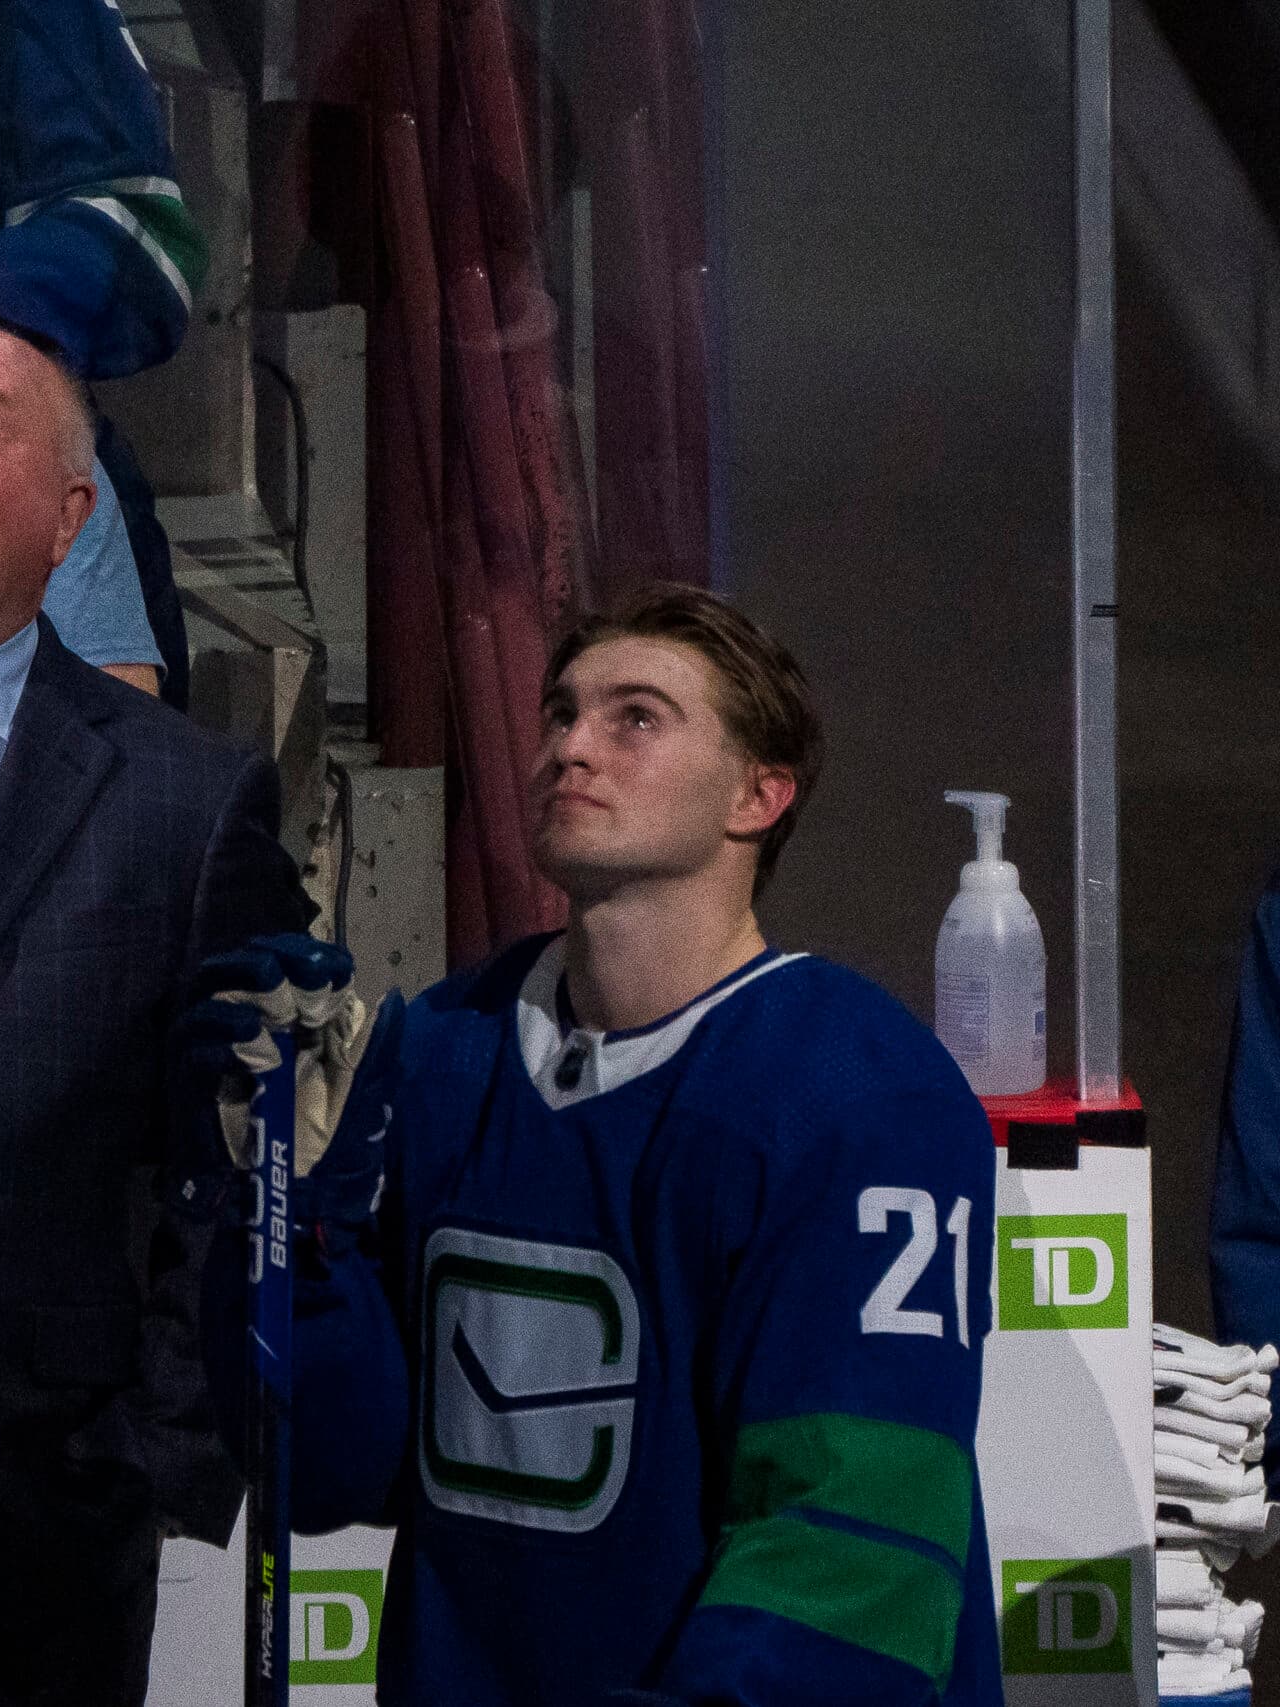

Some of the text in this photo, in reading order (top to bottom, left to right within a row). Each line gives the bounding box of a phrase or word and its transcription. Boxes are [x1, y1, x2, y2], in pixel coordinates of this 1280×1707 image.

[270, 1138, 288, 1270] BAUER
[857, 1185, 972, 1350] 21
[1010, 1236, 1114, 1306] TD
[1015, 1582, 1119, 1650] TD
